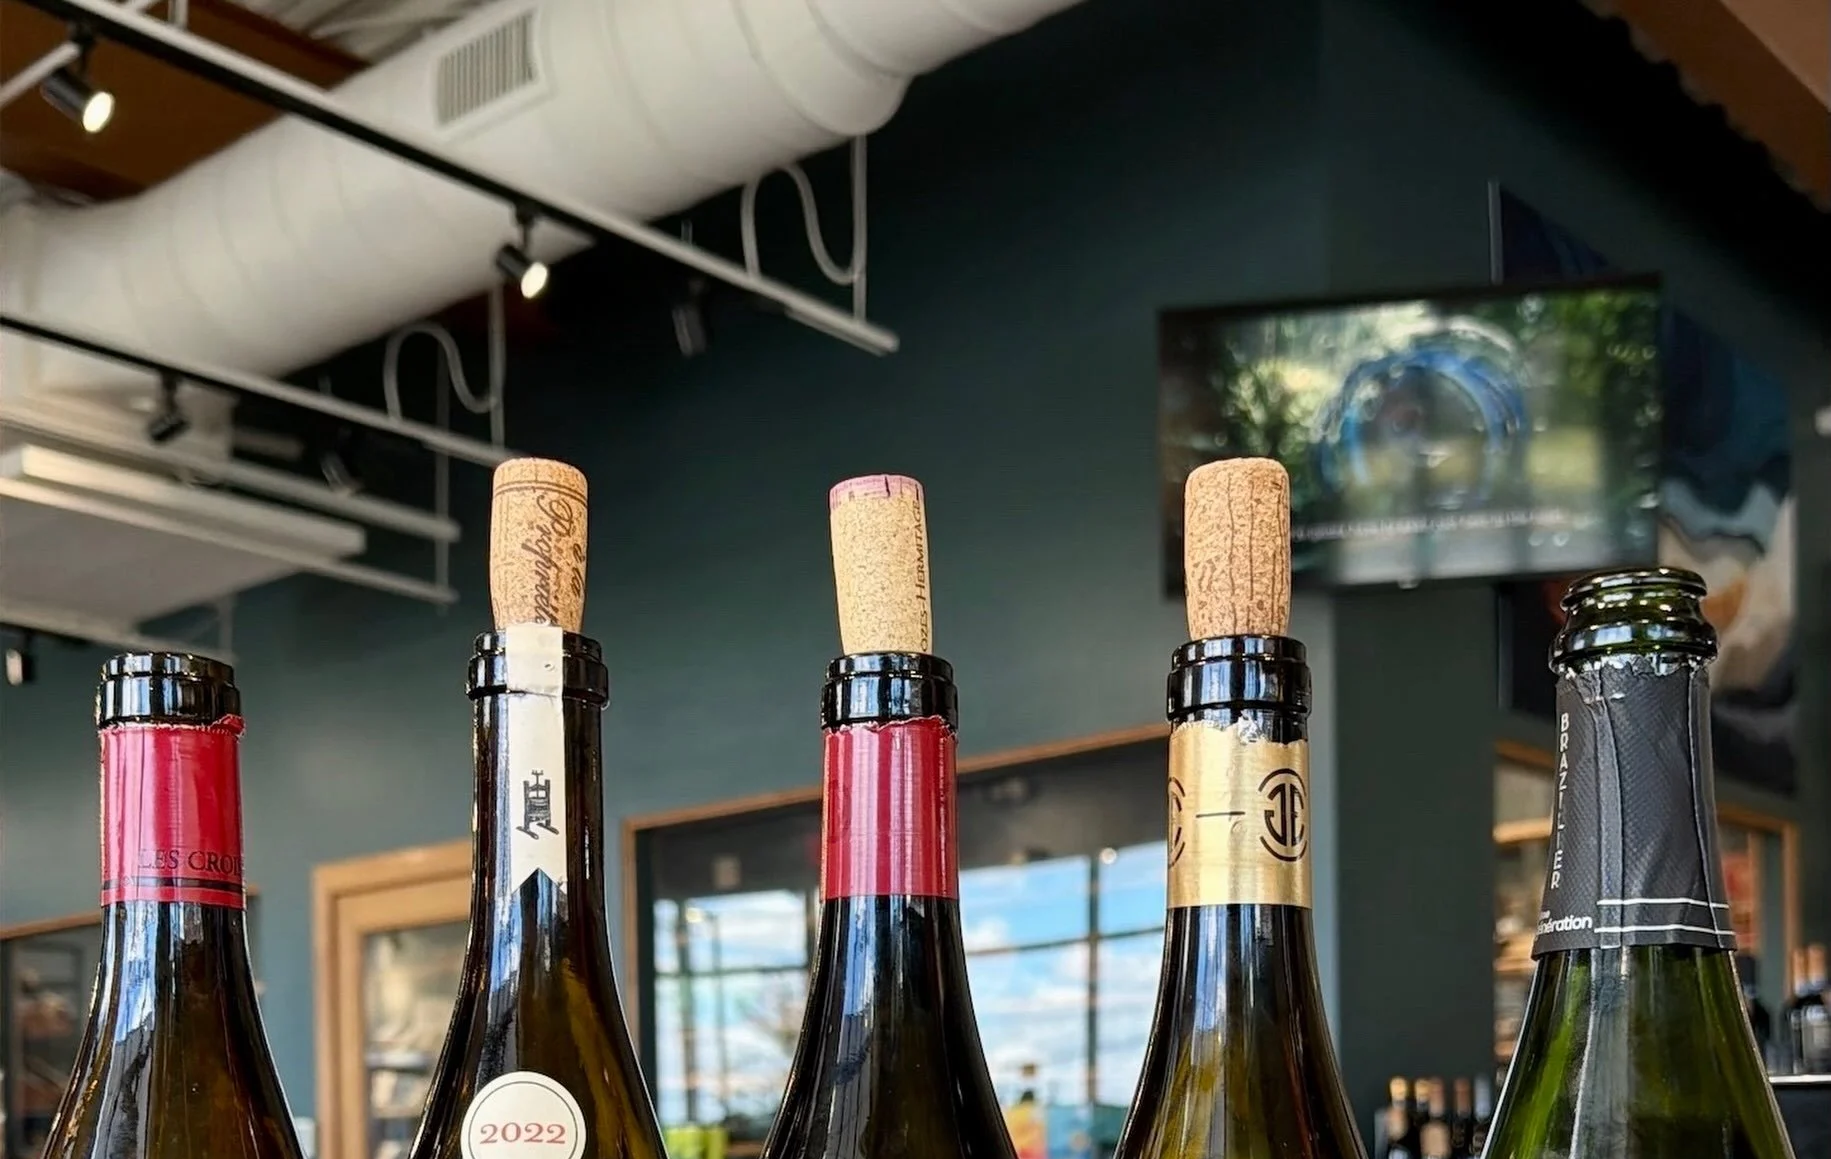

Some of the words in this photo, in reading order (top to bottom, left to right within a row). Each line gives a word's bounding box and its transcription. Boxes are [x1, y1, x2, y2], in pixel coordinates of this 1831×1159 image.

[1551, 712, 1569, 890] BRAZILIER
[138, 849, 179, 870] LES
[479, 1122, 566, 1145] 2022
